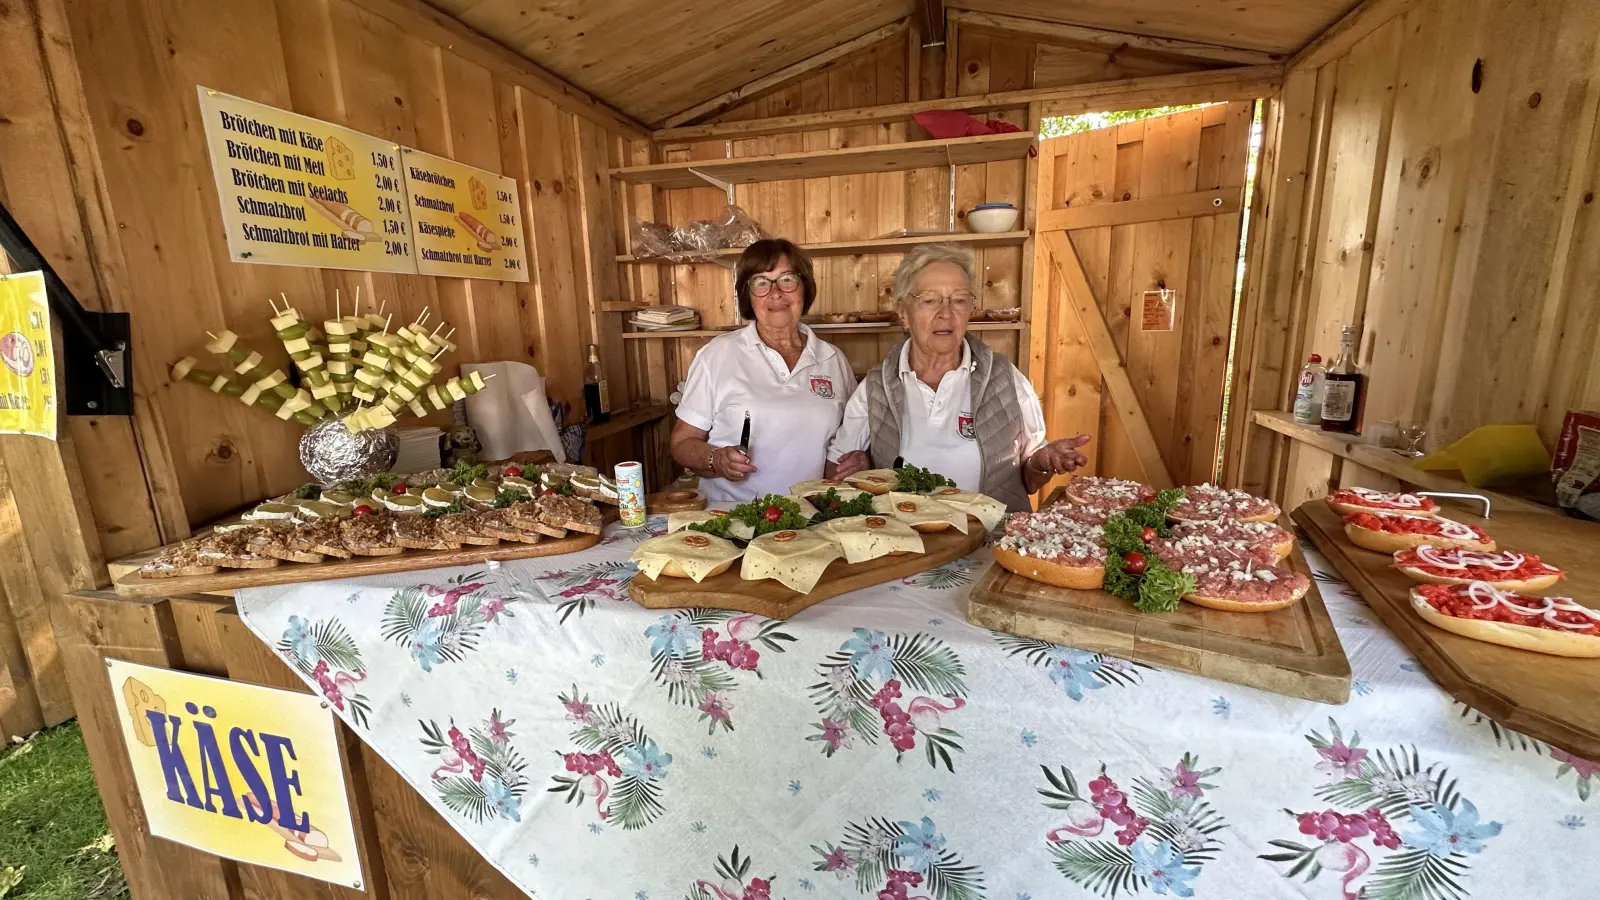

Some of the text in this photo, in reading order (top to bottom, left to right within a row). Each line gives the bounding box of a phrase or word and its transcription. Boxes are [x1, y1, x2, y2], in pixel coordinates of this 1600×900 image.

[219, 111, 324, 152] Brötchen mit Käse
[226, 140, 325, 176] Brötchen mit Mett
[371, 151, 395, 171] 1,50 €
[231, 167, 349, 204] Brötchen mit Seelachs
[375, 174, 400, 193] 2,00 €
[409, 167, 456, 190] Käsebrötchen
[237, 196, 307, 221] Schmalzbrot
[378, 196, 402, 214] 2,00 €
[414, 194, 455, 213] Schmalzbrot
[242, 223, 361, 251] Schmalzbrot mit Harzer
[383, 219, 407, 236] 1,50 €
[385, 240, 409, 256] 2,00 €
[421, 248, 461, 264] Schmalzbrot
[463, 253, 473, 265] mit
[145, 701, 310, 833] KÄSE
